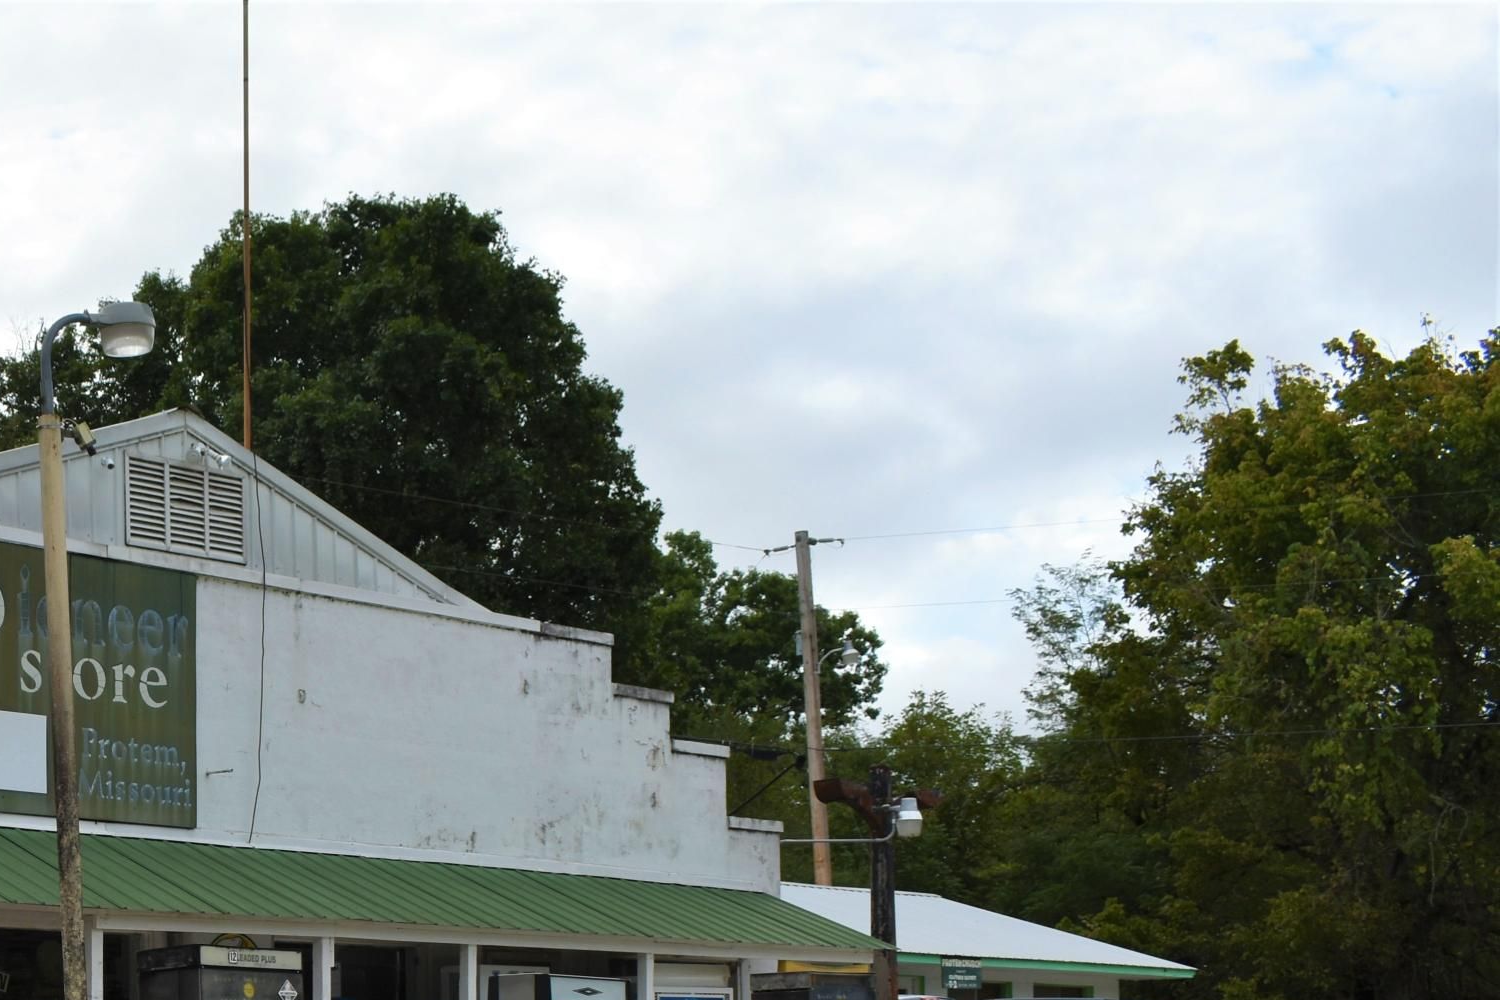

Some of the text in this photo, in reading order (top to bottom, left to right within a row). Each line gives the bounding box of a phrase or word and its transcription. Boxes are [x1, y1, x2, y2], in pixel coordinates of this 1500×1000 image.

[20, 649, 168, 708] sore
[80, 728, 186, 775] Protem,
[79, 768, 192, 807] Missouri
